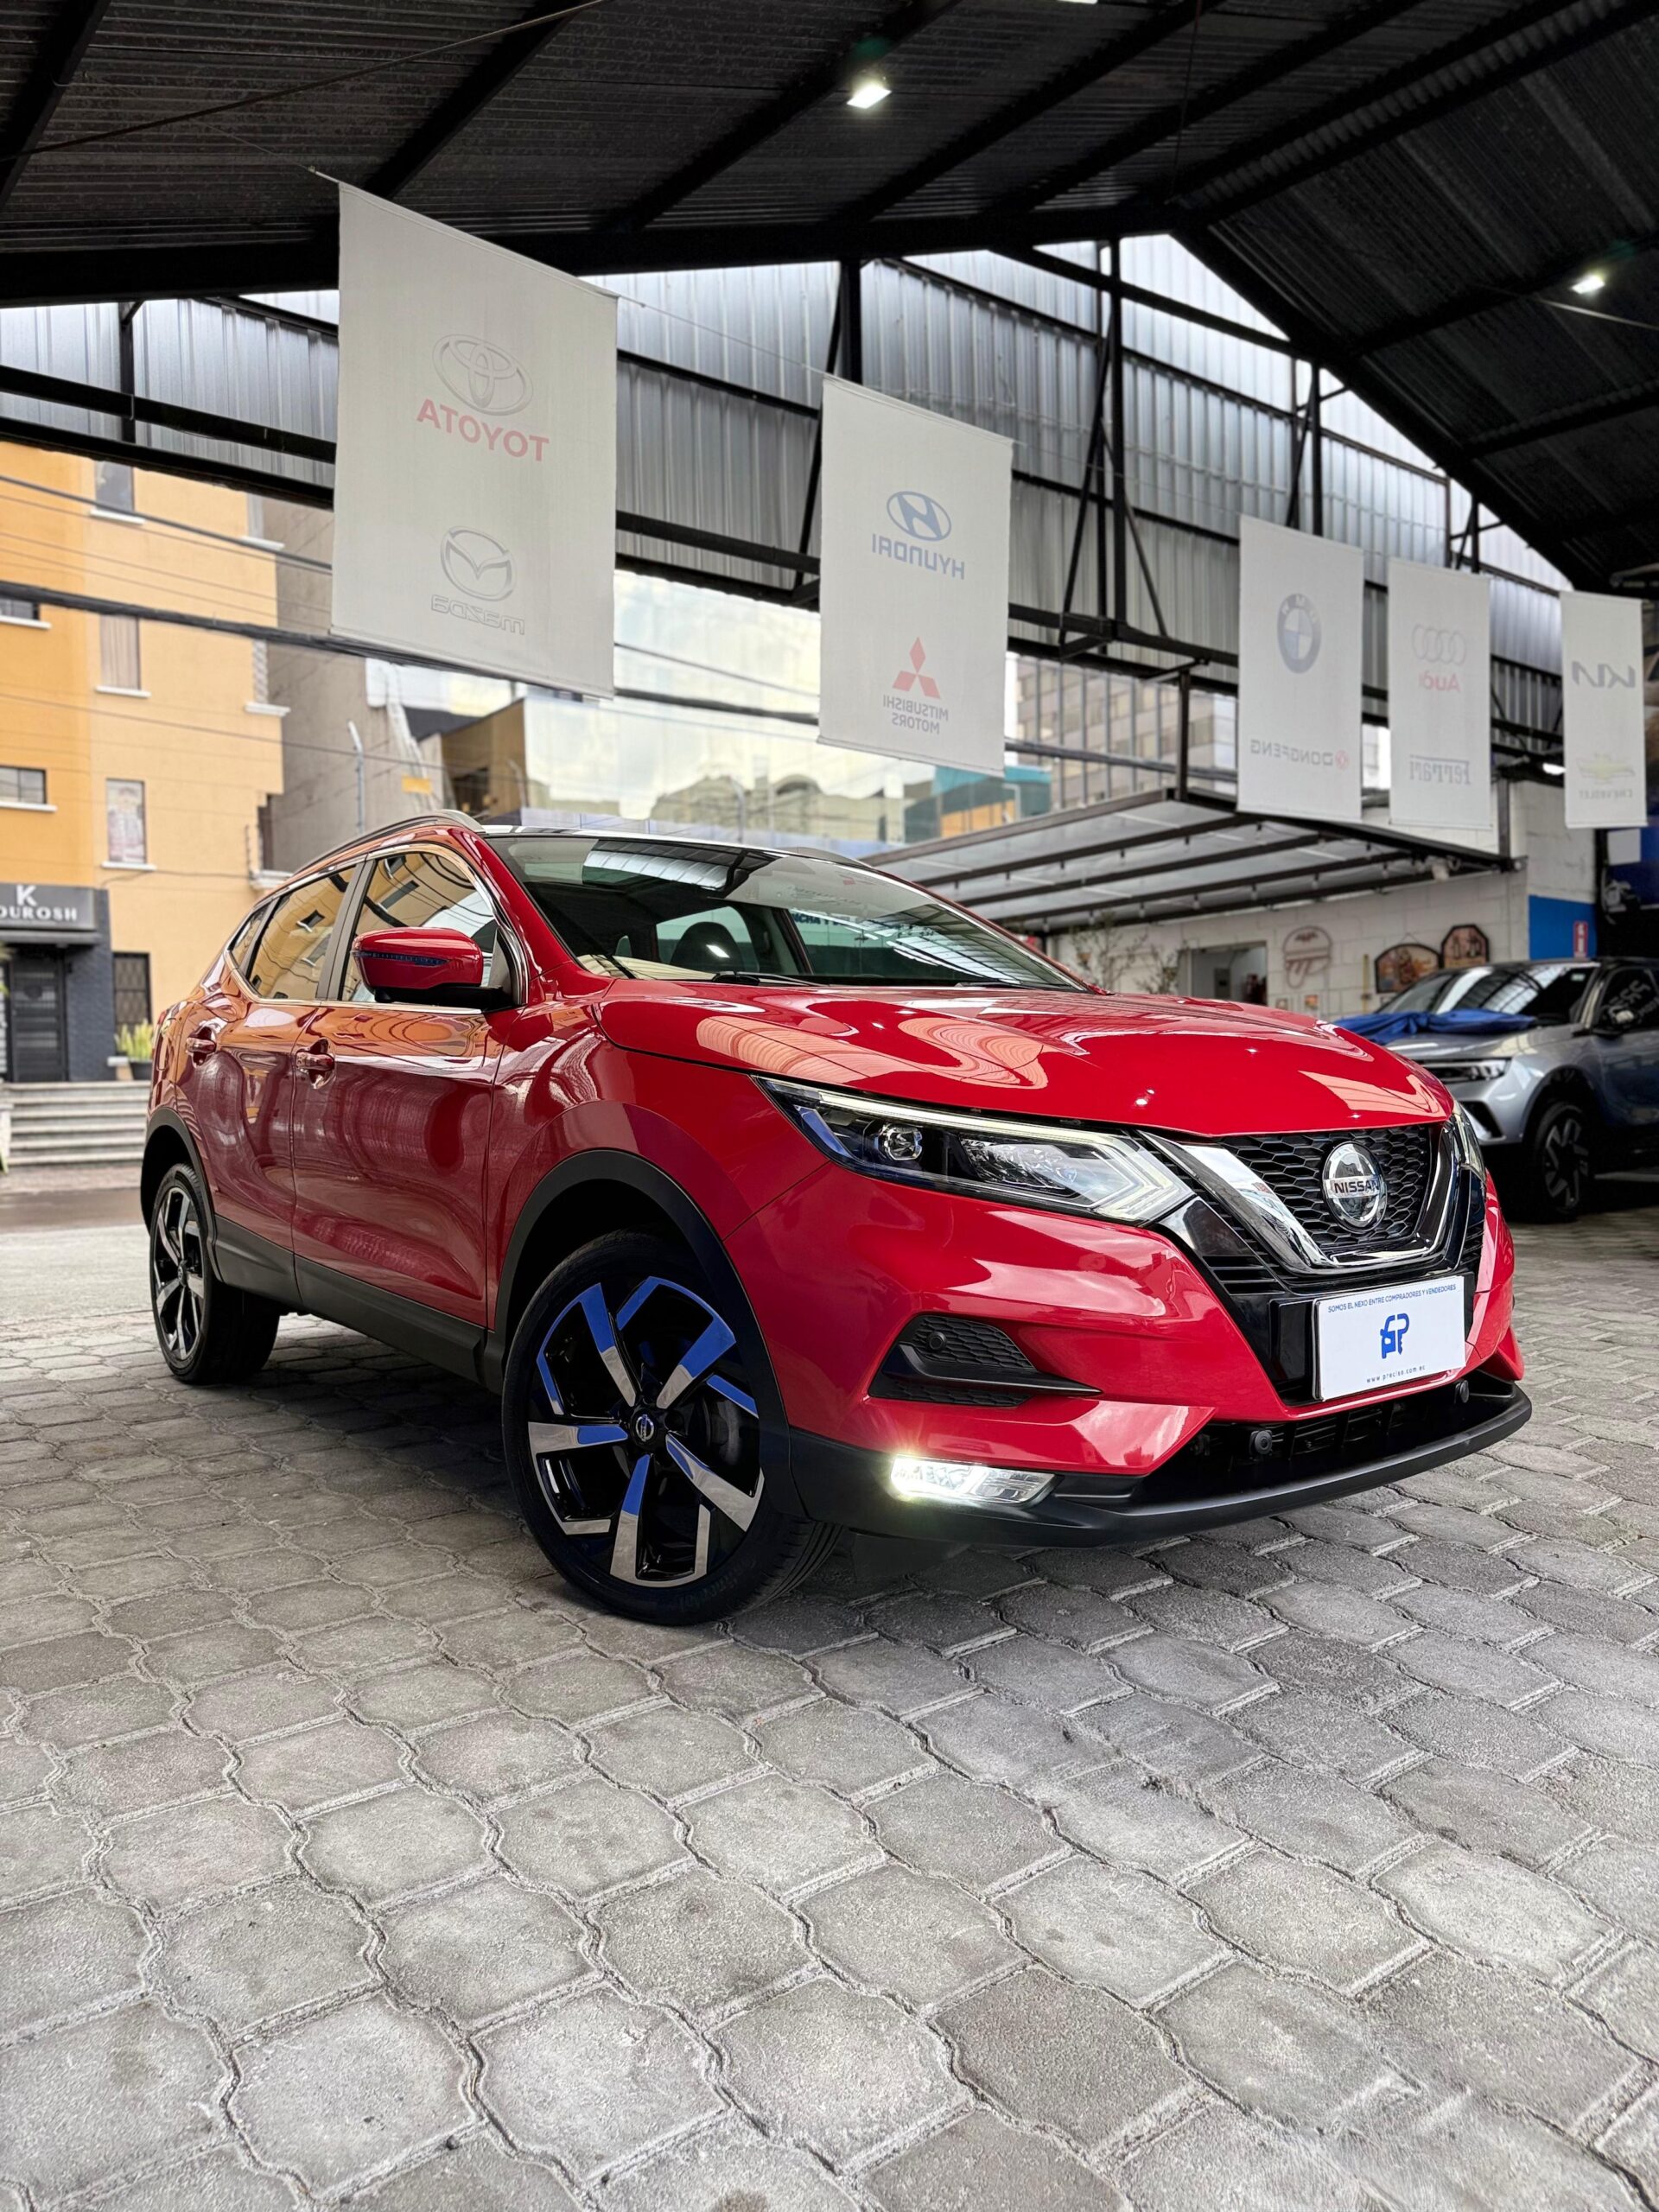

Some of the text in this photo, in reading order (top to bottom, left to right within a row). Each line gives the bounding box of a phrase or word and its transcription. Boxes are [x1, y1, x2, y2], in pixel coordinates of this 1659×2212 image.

[16, 884, 37, 906] K
[1333, 1179, 1380, 1194] NISSAN
[1328, 1303, 1347, 1313] SOMOS
[1369, 1297, 1384, 1306] ENTRE
[1385, 1290, 1421, 1302] COMPRADORES
[1425, 1284, 1456, 1294] VENDEDORES
